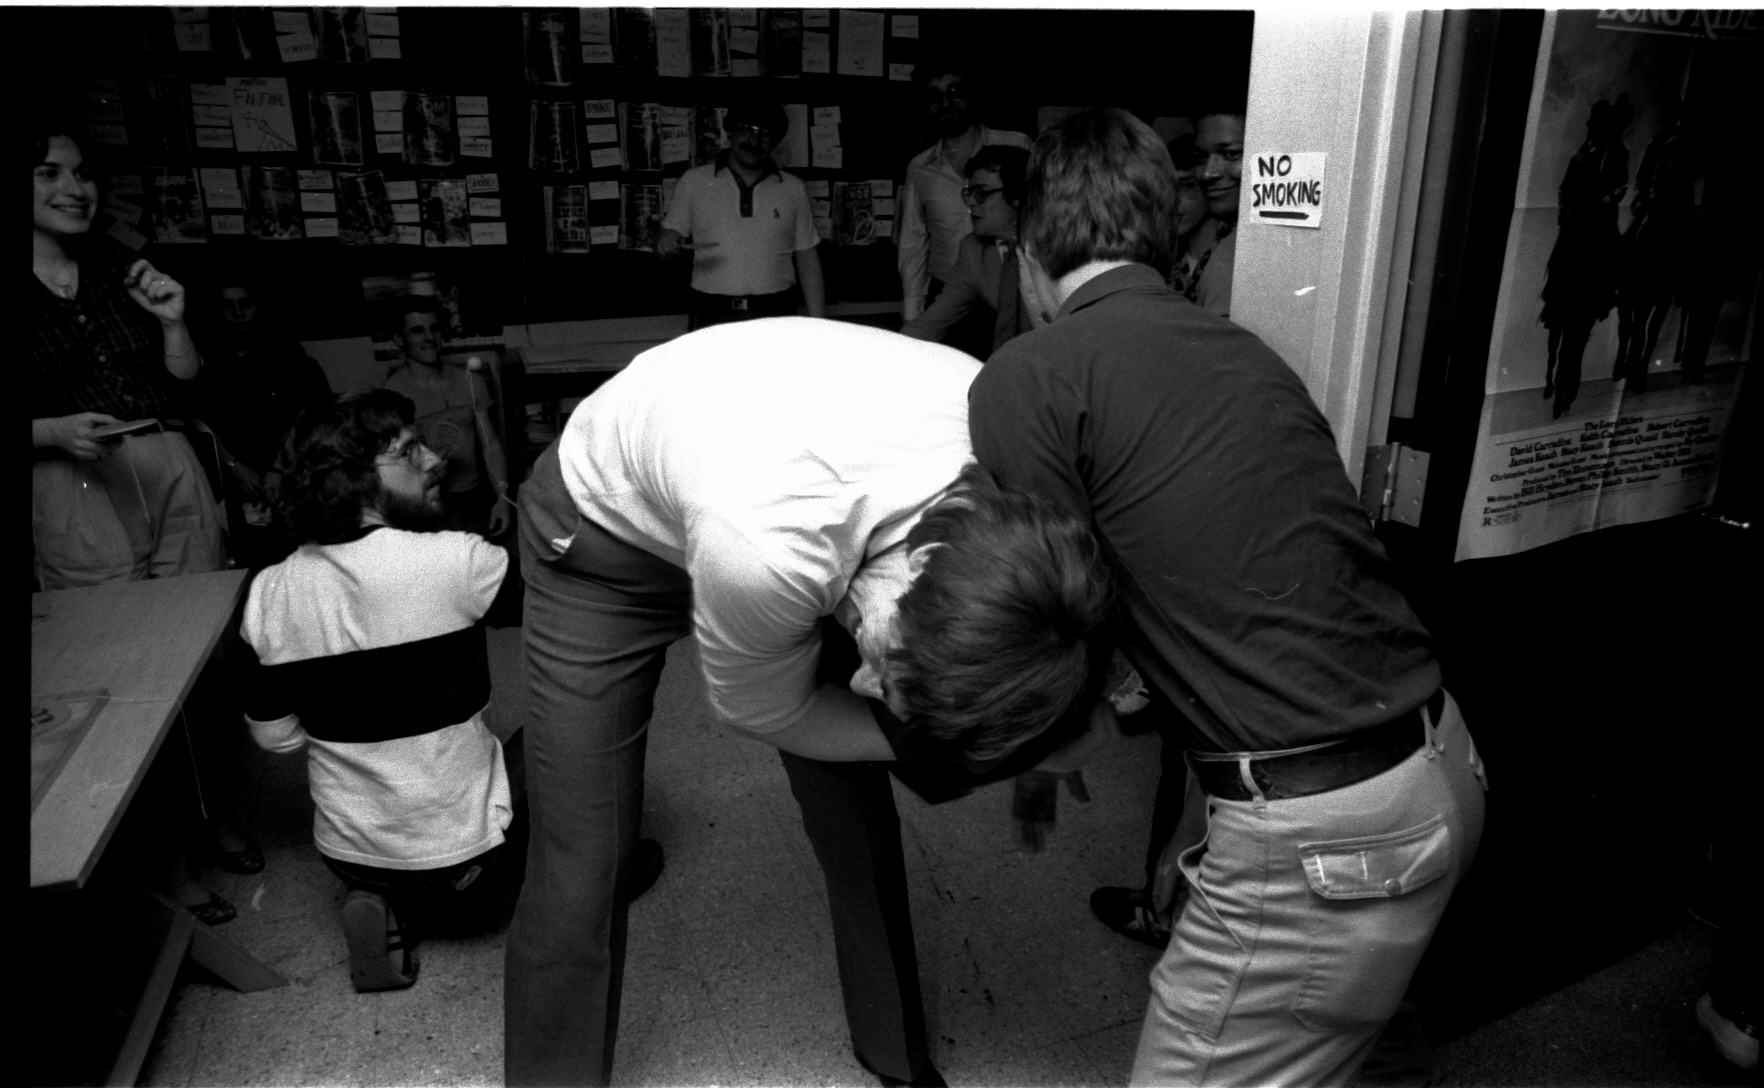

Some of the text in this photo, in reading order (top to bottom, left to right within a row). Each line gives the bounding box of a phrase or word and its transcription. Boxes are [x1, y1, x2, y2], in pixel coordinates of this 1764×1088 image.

[1258, 155, 1291, 176] NO
[1253, 180, 1321, 207] SMOKING
[1584, 422, 1599, 431] The
[1510, 444, 1532, 456] David
[1534, 438, 1571, 452] Carradine
[1580, 432, 1600, 442] Keith
[1601, 428, 1638, 438] Carradine
[1509, 458, 1533, 468] James
[1535, 451, 1557, 462] Keach
[1561, 447, 1579, 456] Stacy
[1580, 442, 1603, 452] Keach
[1635, 432, 1658, 444] Quaid
[1490, 470, 1527, 482] Christopher
[1557, 469, 1572, 478] Tim
[1487, 494, 1512, 503] Written
[1521, 486, 1535, 497] Bill
[1547, 489, 1569, 501] James
[1483, 517, 1491, 525] R
